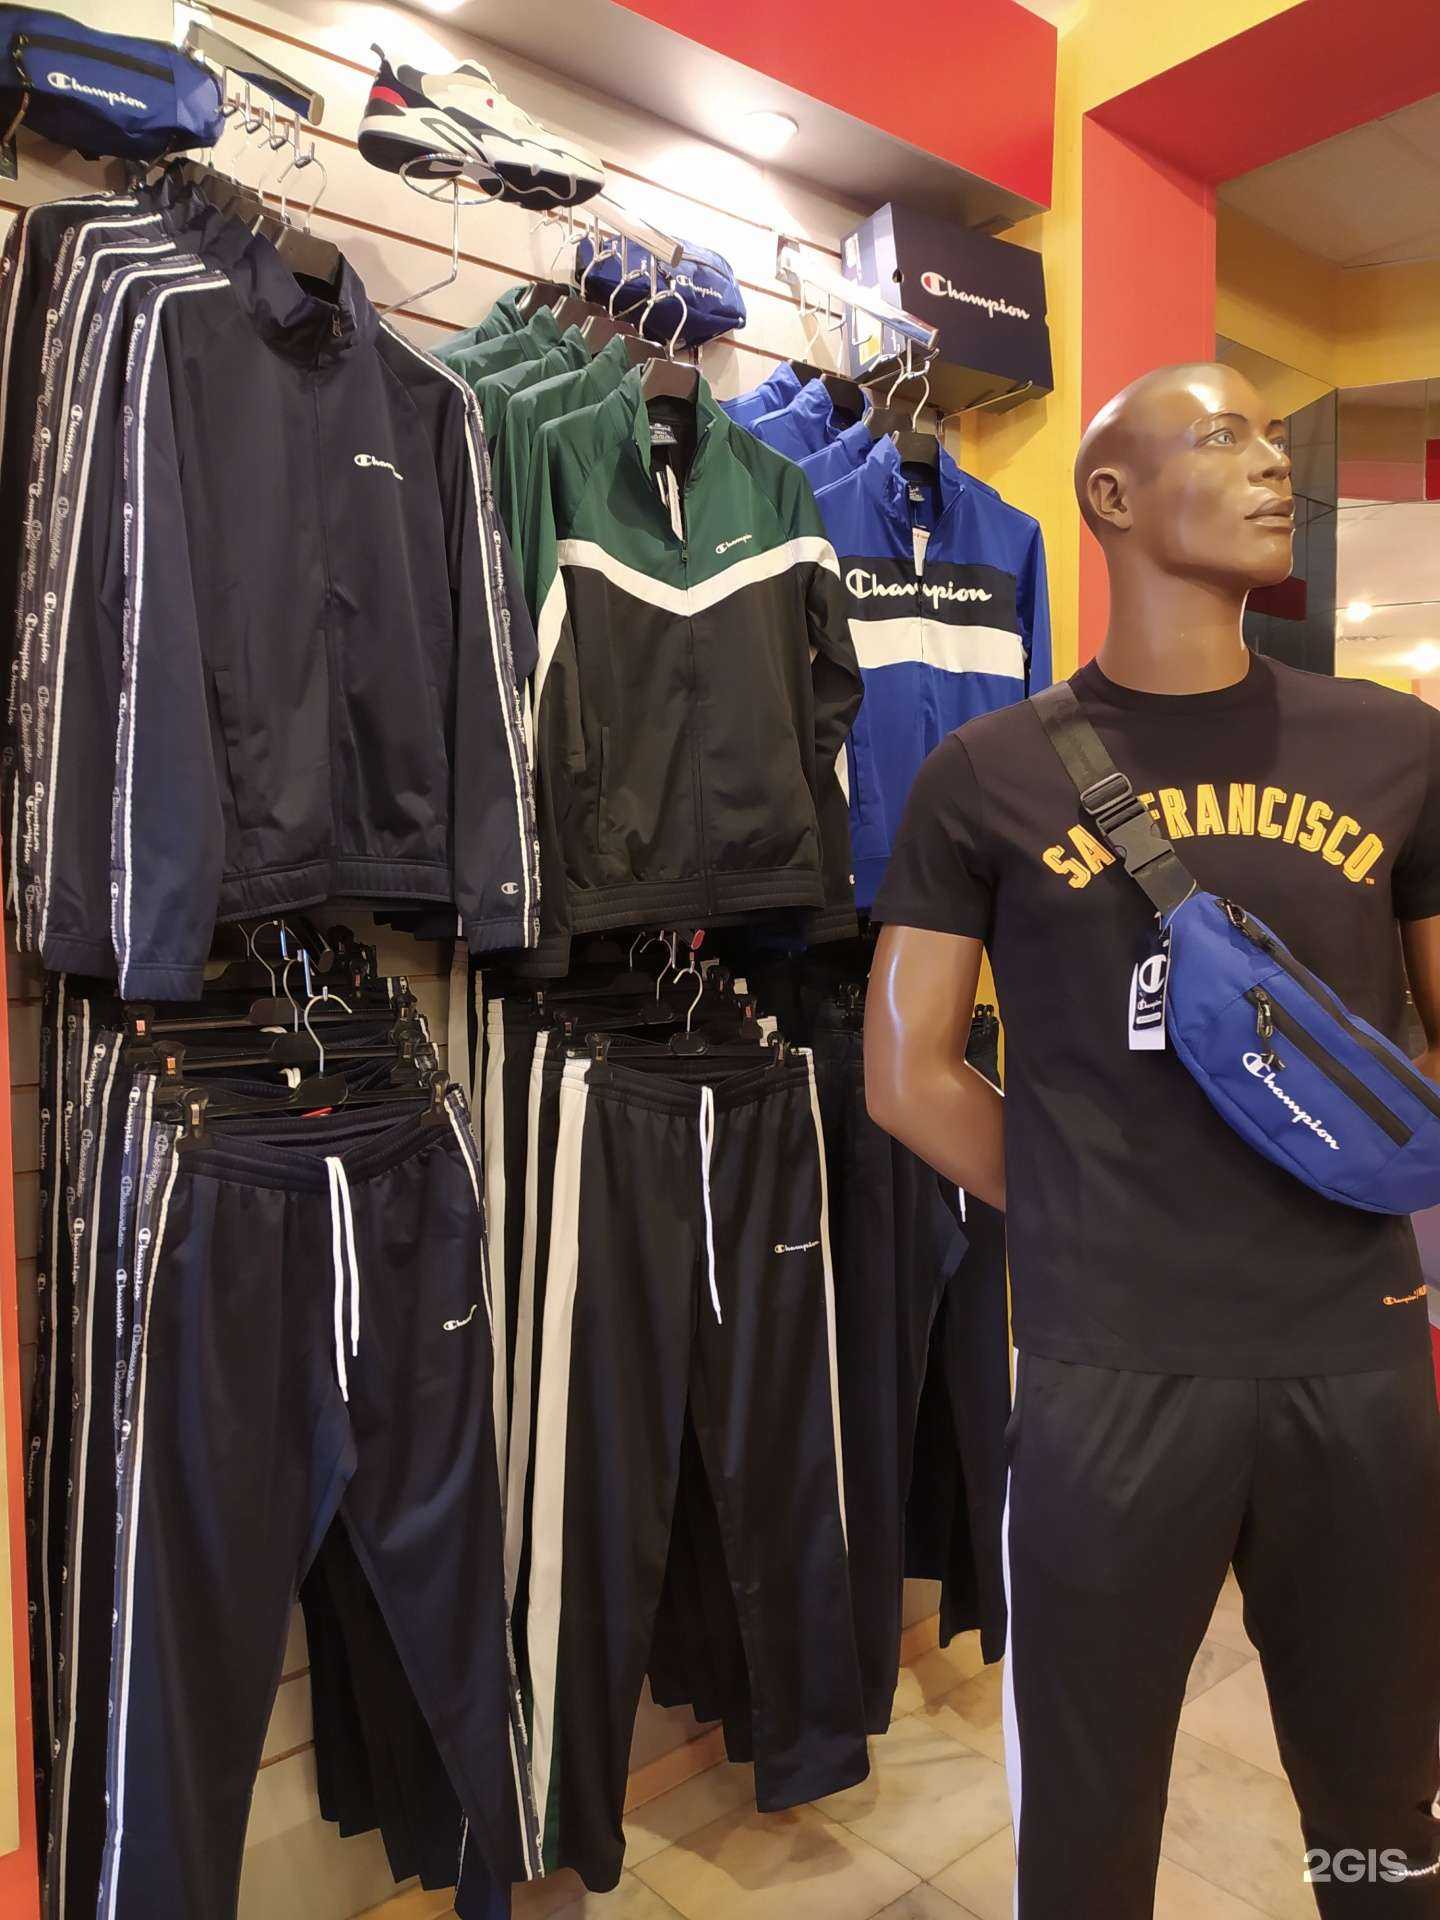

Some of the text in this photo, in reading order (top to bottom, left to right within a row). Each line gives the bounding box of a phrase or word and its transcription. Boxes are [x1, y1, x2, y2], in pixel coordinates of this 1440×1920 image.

[46, 71, 148, 111] Champion
[675, 274, 723, 299] Champion
[920, 271, 1031, 320] Champion
[846, 568, 992, 610] Champion
[38, 591, 57, 665] Champion
[1042, 824, 1116, 889] SA
[123, 1086, 141, 1153] Champion
[1242, 1053, 1340, 1150] Champion
[133, 1227, 152, 1302] Champion
[774, 1240, 820, 1254] Champion
